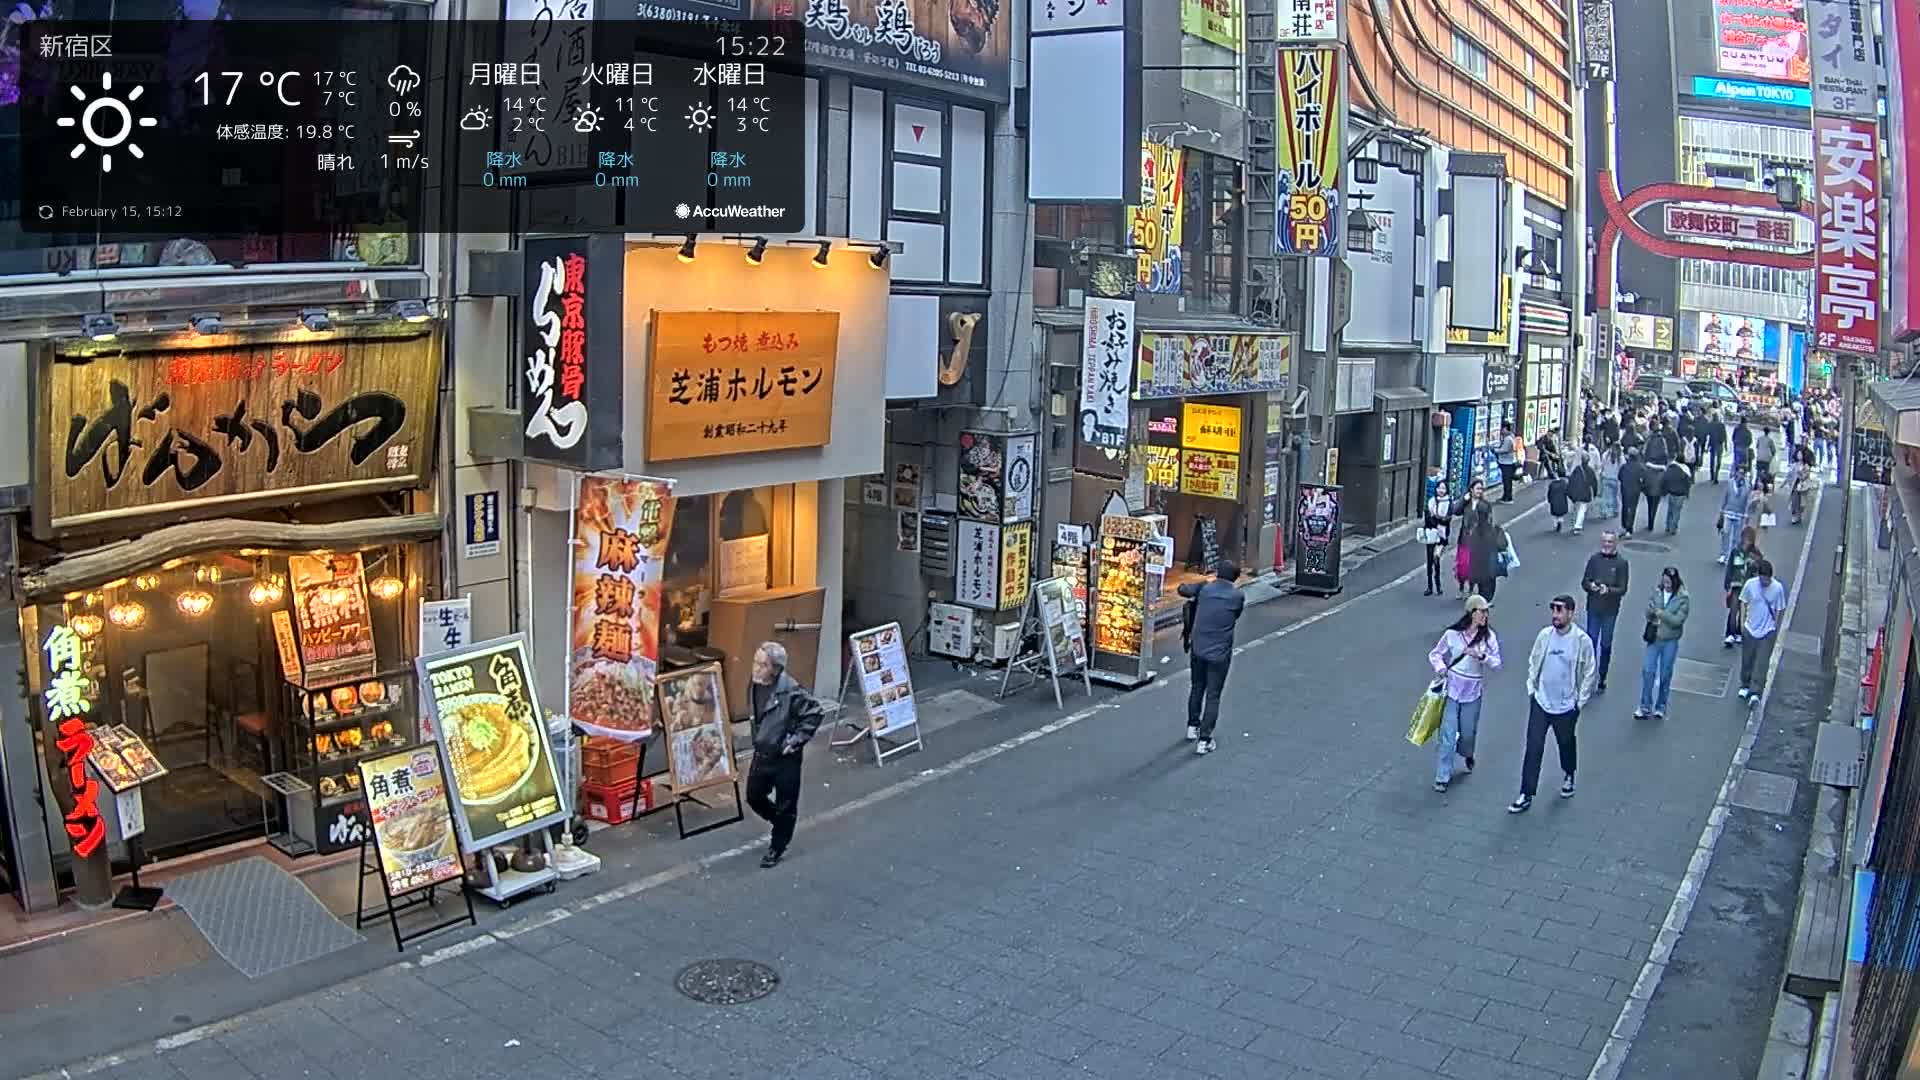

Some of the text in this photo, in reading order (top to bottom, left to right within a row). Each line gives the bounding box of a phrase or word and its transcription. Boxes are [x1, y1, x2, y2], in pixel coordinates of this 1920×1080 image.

[1590, 63, 1609, 78] 7F
[1715, 81, 1794, 100] Alpen TOKYO
[1832, 96, 1856, 110] 3F
[1295, 53, 1322, 190] ハイボール
[1288, 196, 1327, 221] 50
[1135, 218, 1157, 250] 50
[1295, 223, 1321, 250] 円
[1670, 210, 1790, 241] 歌舞伎町一番街
[1820, 126, 1876, 328] 安楽亭
[561, 253, 586, 400] 東京豚骨
[703, 330, 800, 353] もつ焼 煮込み
[1819, 332, 1837, 347] 2F
[1100, 308, 1129, 414] お好み焼き
[669, 366, 823, 405] 芝浦ホルモン
[973, 527, 984, 600] 芝浦ホルモン
[1003, 552, 1017, 600] 作動中
[369, 767, 414, 800] 角煮
